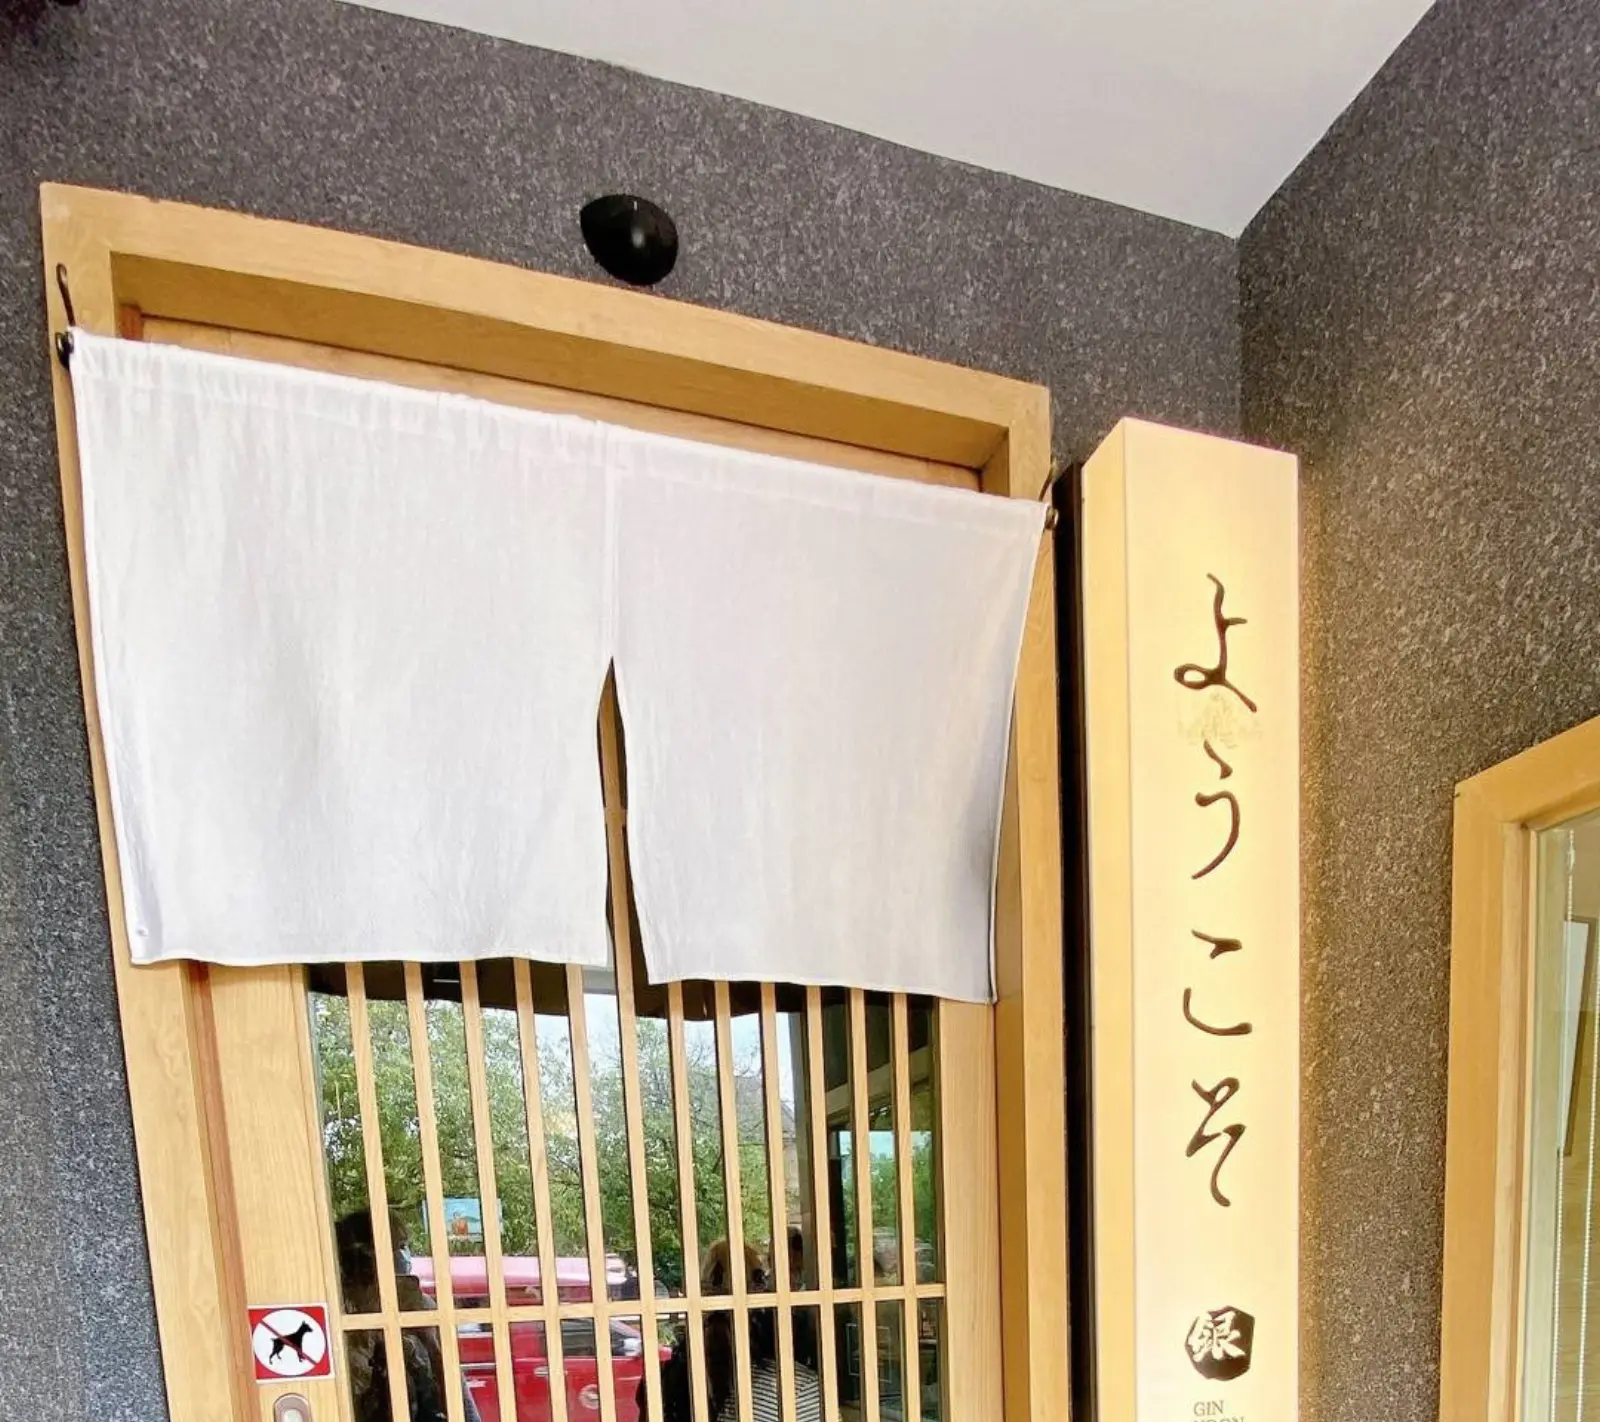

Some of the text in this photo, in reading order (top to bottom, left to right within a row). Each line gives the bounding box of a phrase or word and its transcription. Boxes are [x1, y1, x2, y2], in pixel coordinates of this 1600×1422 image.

[1174, 573, 1257, 1207] ようこそ
[1193, 1400, 1224, 1417] GIN
